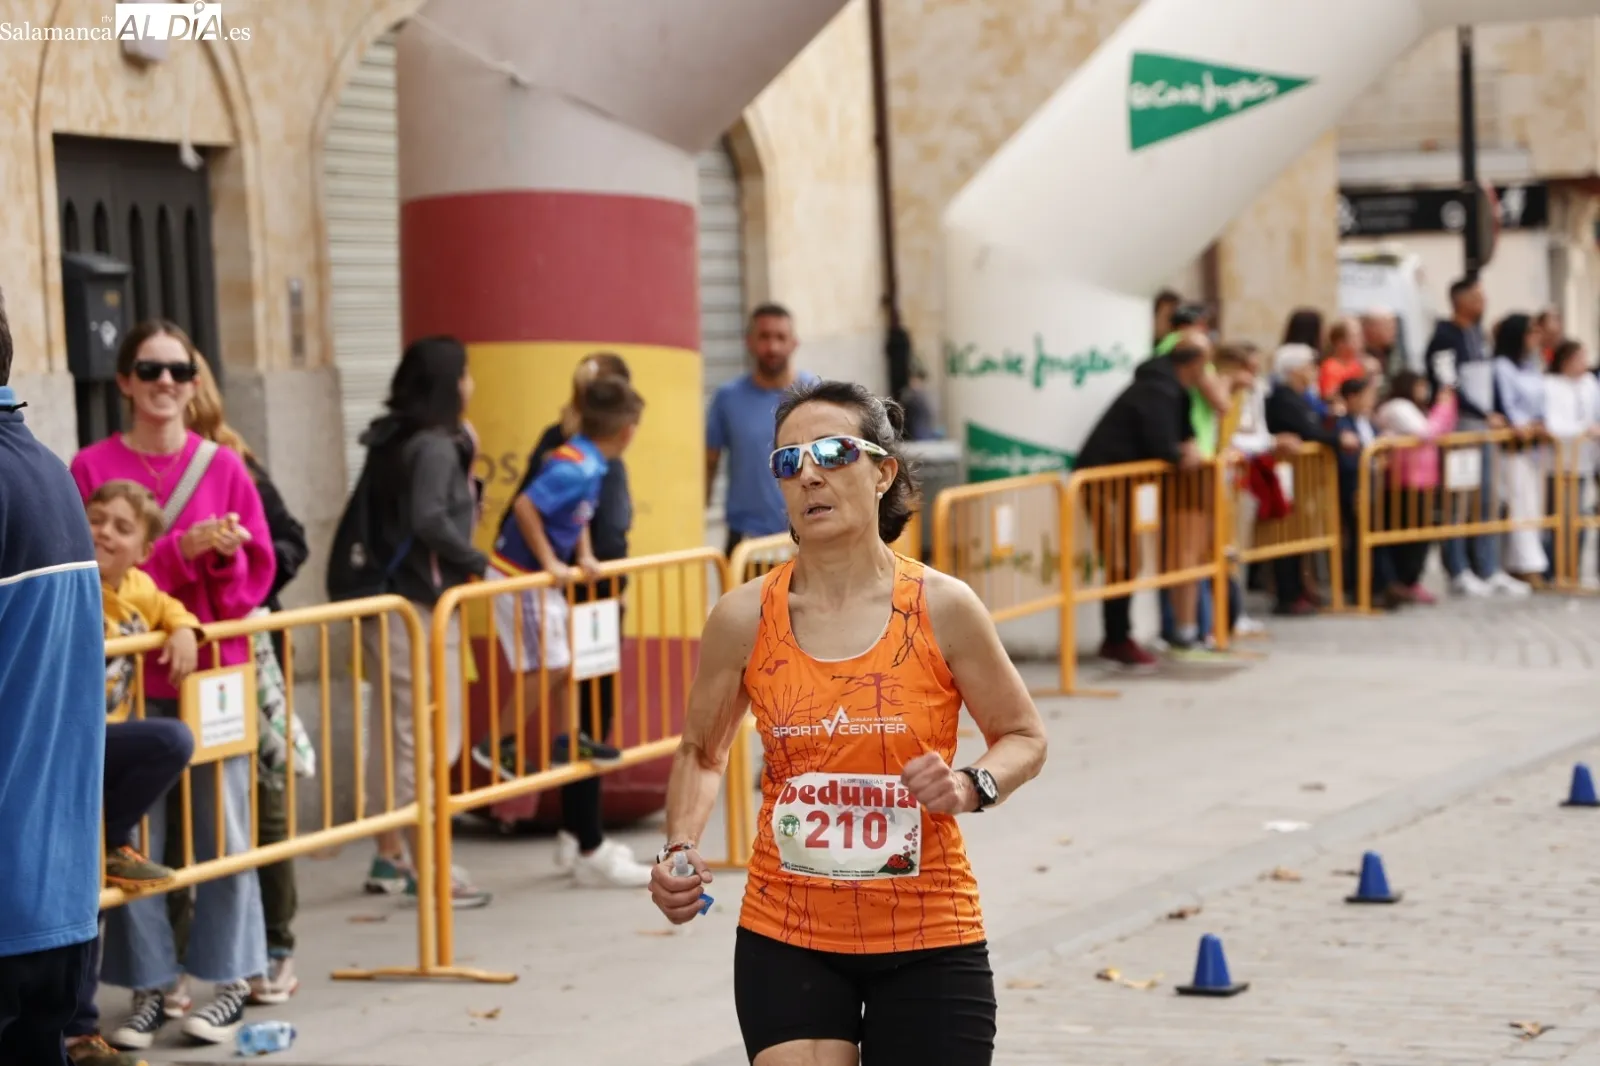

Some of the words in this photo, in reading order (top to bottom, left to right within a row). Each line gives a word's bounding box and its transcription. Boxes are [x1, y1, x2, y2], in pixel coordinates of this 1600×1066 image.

[772, 725, 822, 738] SPORT
[838, 723, 907, 735] CENTER
[778, 780, 917, 809] bedunia
[805, 810, 888, 850] 210
